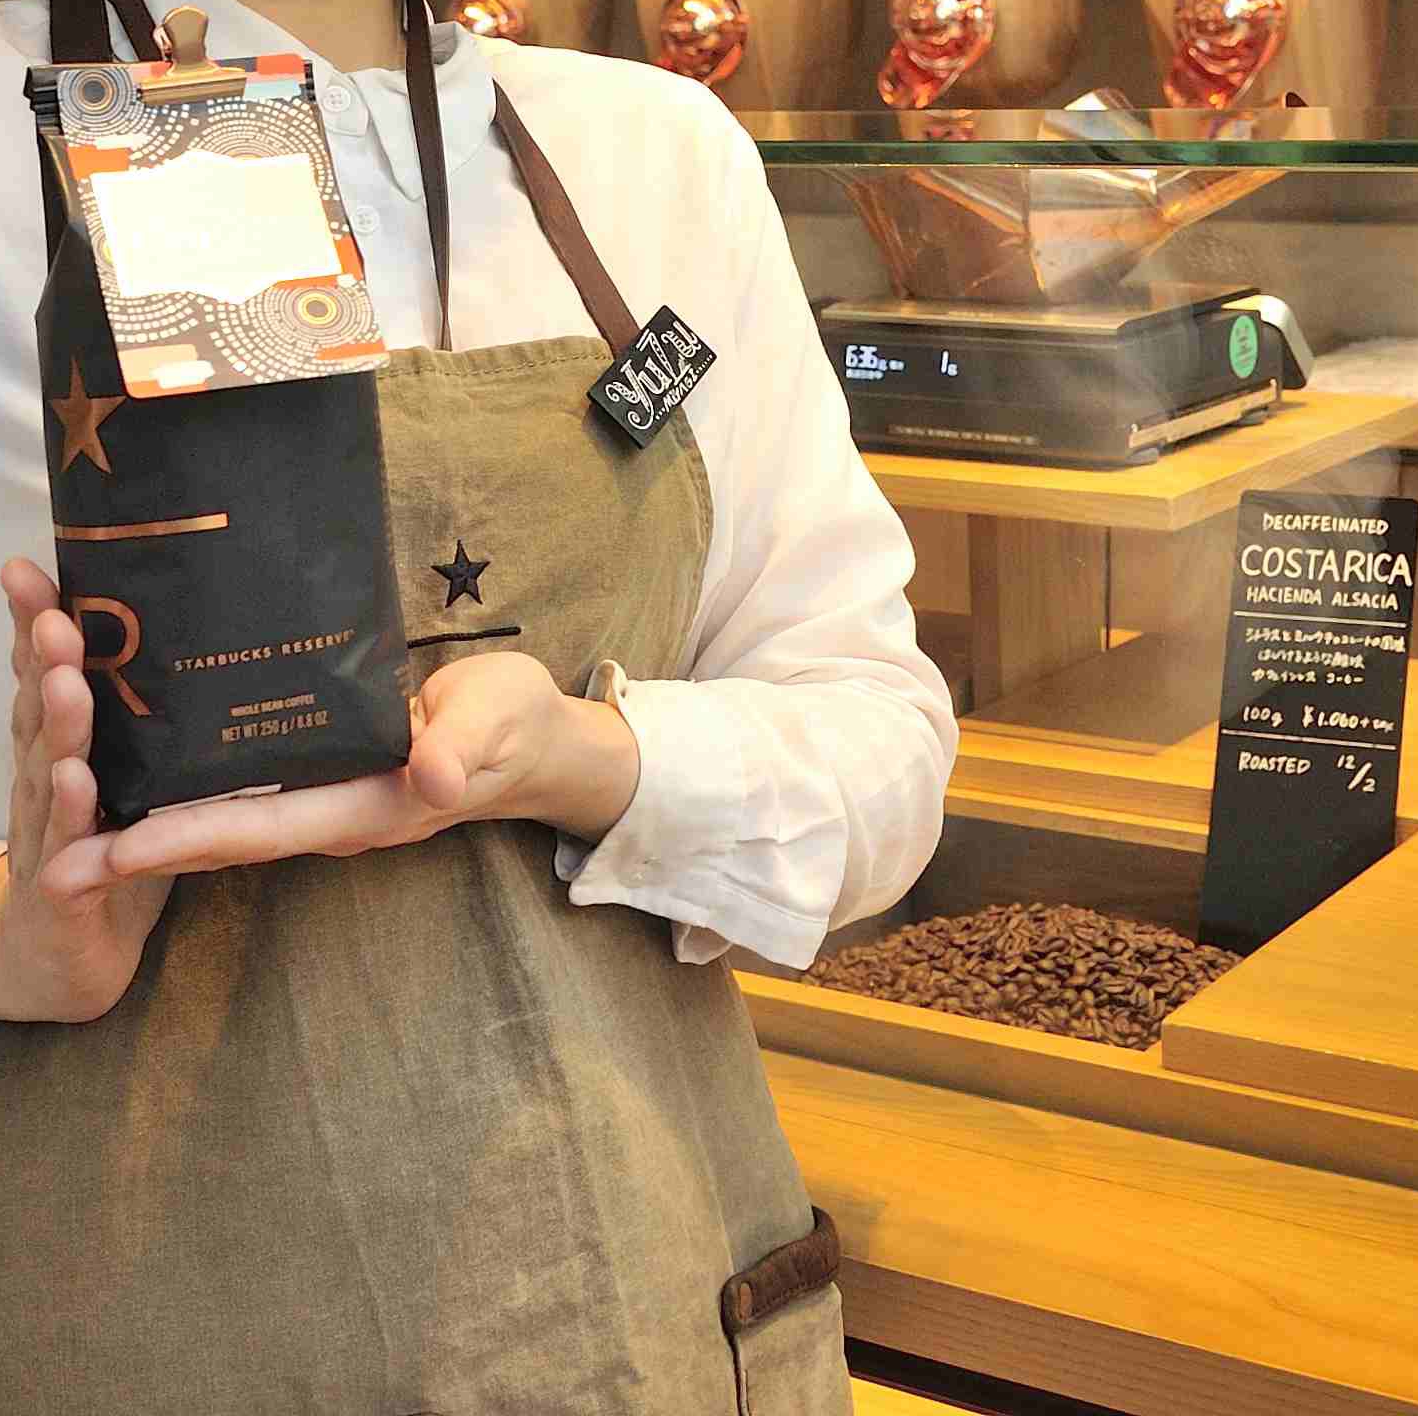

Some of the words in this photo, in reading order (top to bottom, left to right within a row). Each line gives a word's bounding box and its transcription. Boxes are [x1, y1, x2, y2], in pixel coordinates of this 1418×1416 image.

[1263, 512, 1389, 535] DECAFFEINATED
[1246, 586, 1322, 606] HACIENDA
[1331, 591, 1399, 611] ALSACIA
[174, 645, 273, 672] STARBUCKS
[1243, 706, 1284, 727] 100g
[221, 725, 241, 743] NET
[1238, 751, 1311, 775] ROASTED
